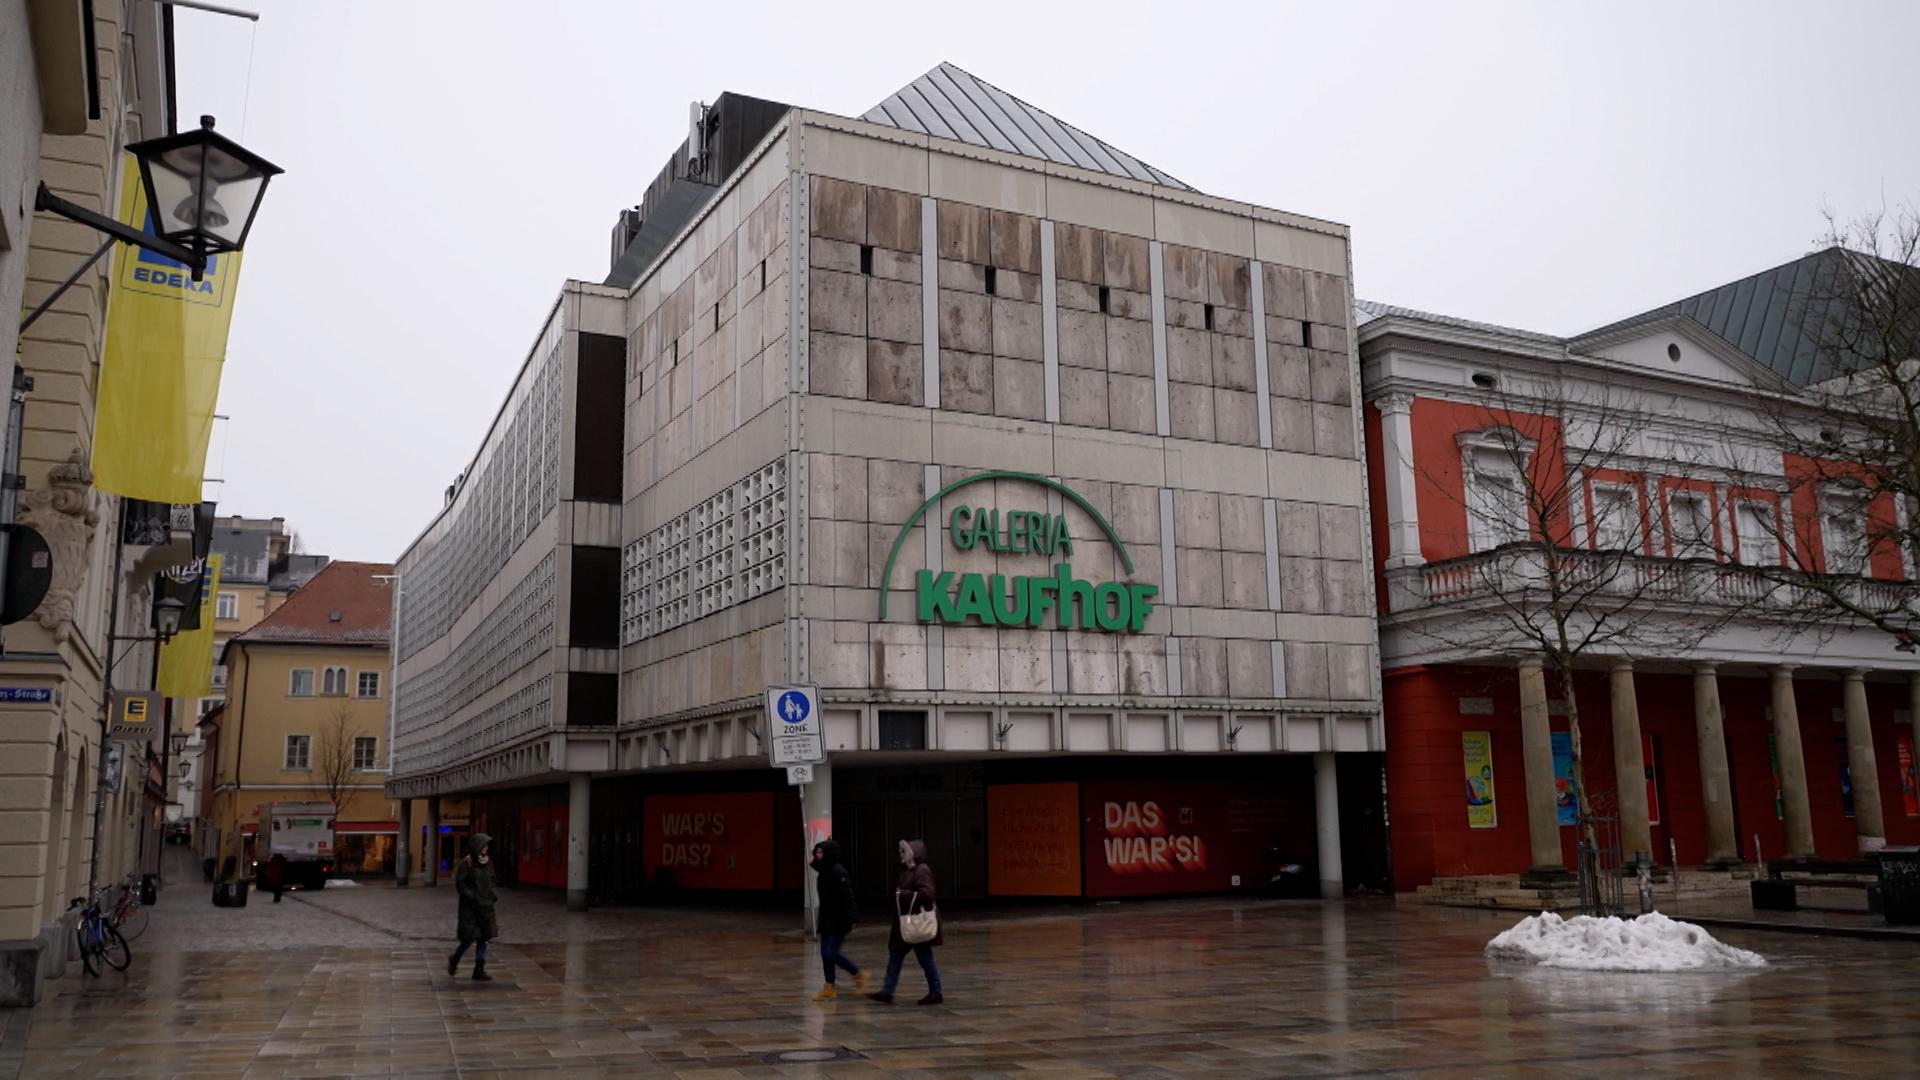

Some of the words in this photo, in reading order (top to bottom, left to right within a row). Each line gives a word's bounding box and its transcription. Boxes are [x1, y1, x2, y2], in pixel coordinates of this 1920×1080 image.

[133, 267, 213, 294] EDEKA
[950, 504, 1074, 556] GALERIA
[783, 724, 808, 734] ZONE
[662, 812, 725, 836] WAR'S
[1104, 800, 1163, 830] DAS
[662, 842, 712, 867] DAS?
[1104, 835, 1203, 866] WAR'S!
